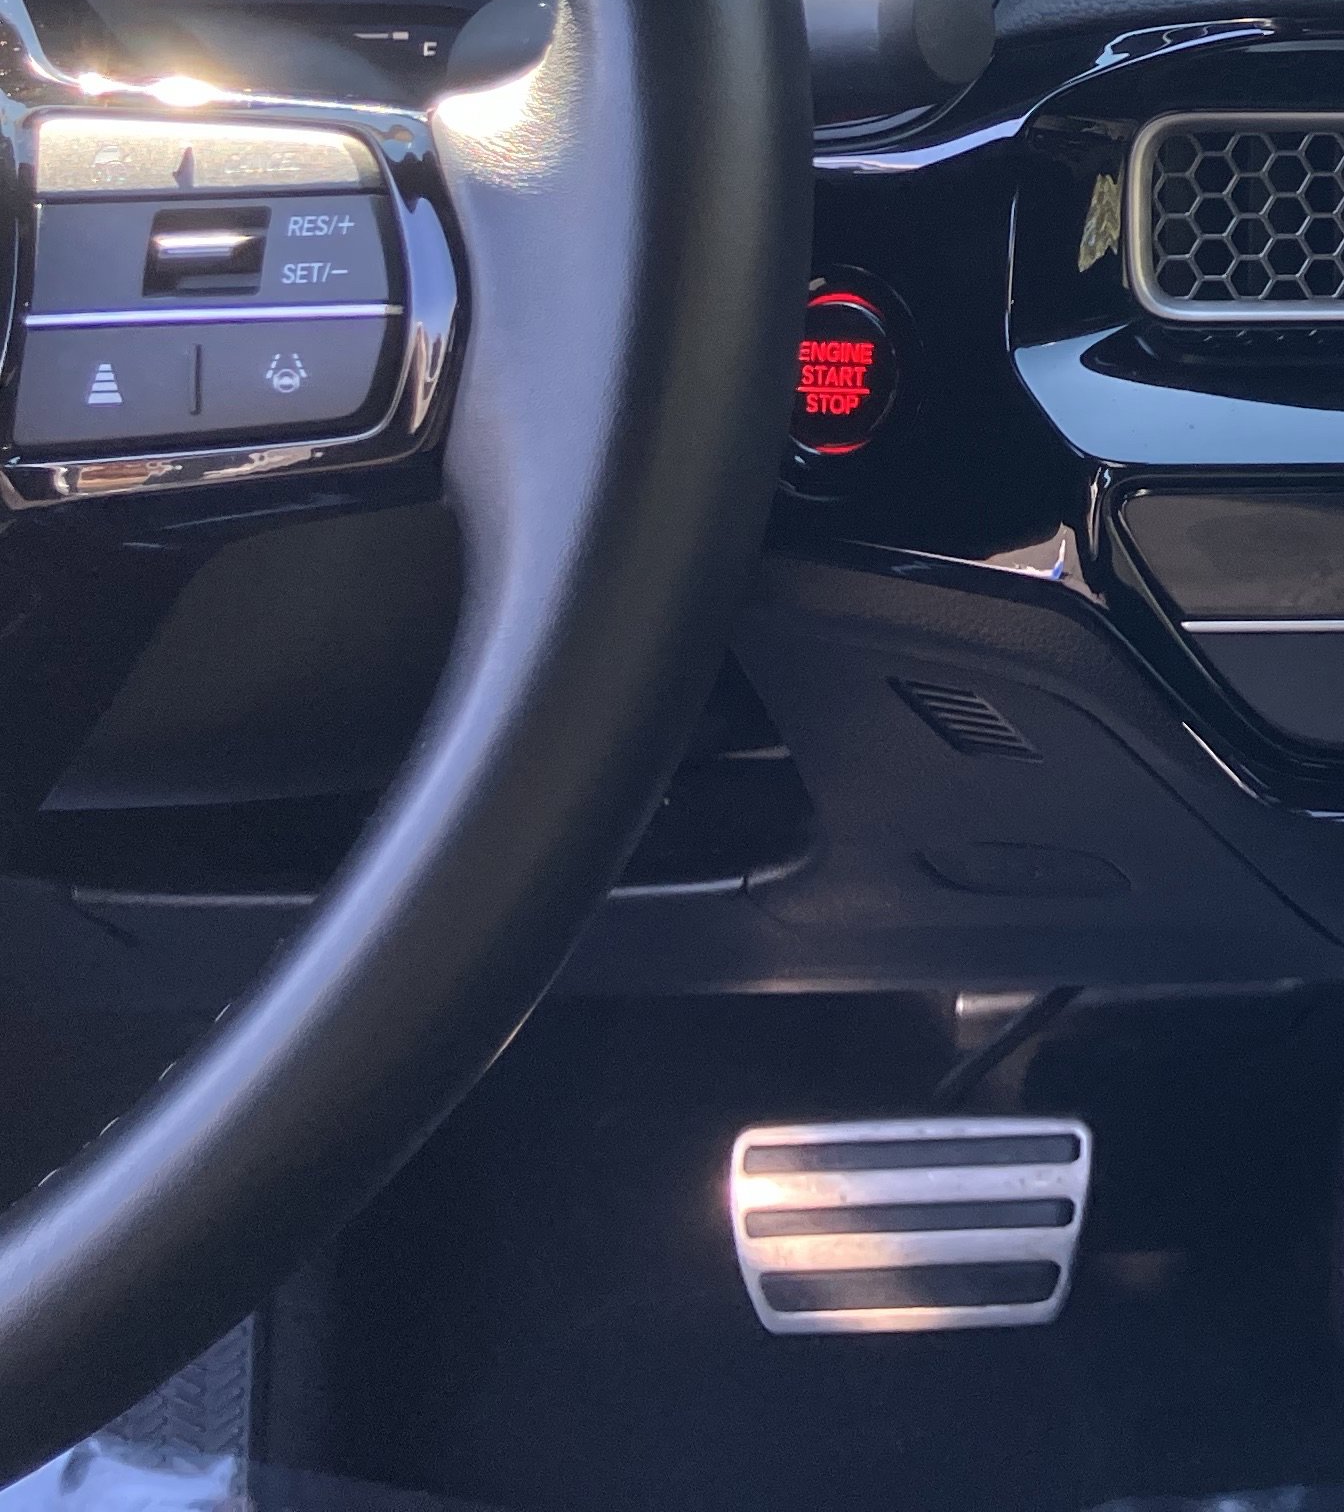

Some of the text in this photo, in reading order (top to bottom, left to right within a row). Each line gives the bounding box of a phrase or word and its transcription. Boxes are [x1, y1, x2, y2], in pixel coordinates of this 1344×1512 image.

[798, 341, 875, 365] ENGINE
[801, 365, 867, 386] START
[806, 394, 861, 415] STOP
